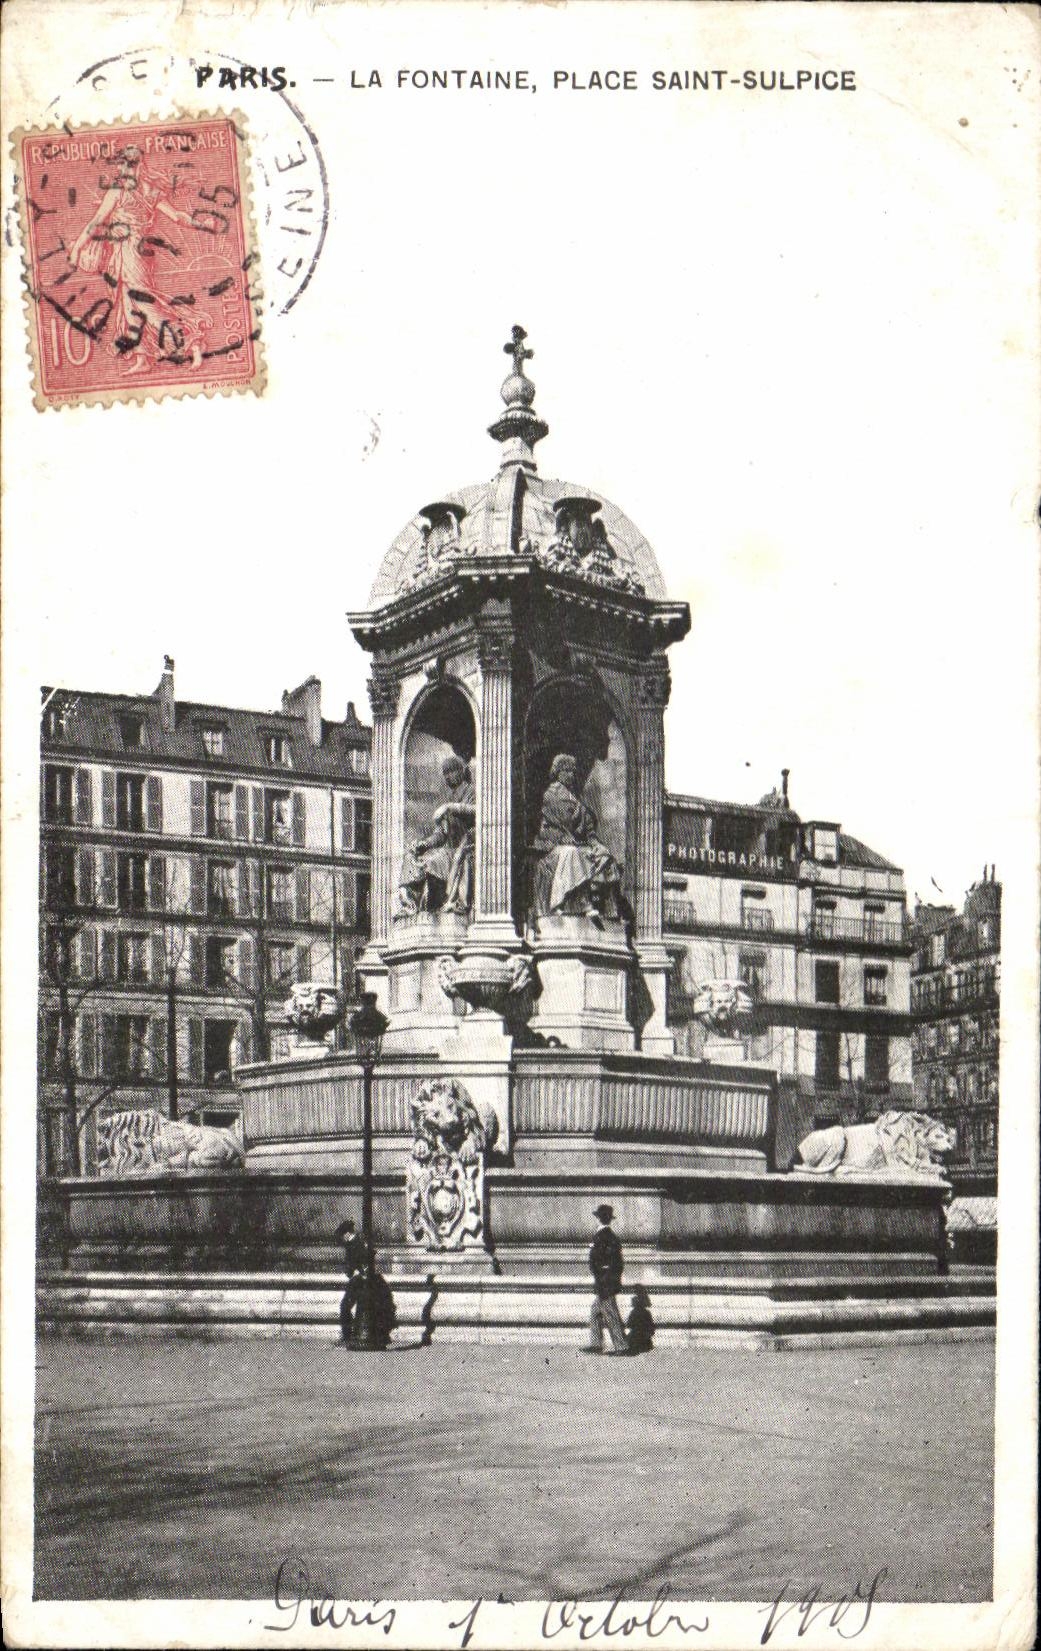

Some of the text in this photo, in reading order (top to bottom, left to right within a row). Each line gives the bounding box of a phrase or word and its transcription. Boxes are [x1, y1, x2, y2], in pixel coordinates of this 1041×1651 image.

[50, 315, 91, 367] 10
[668, 843, 785, 869] PHOTOGRAPHIE
[263, 1557, 396, 1634] Paris
